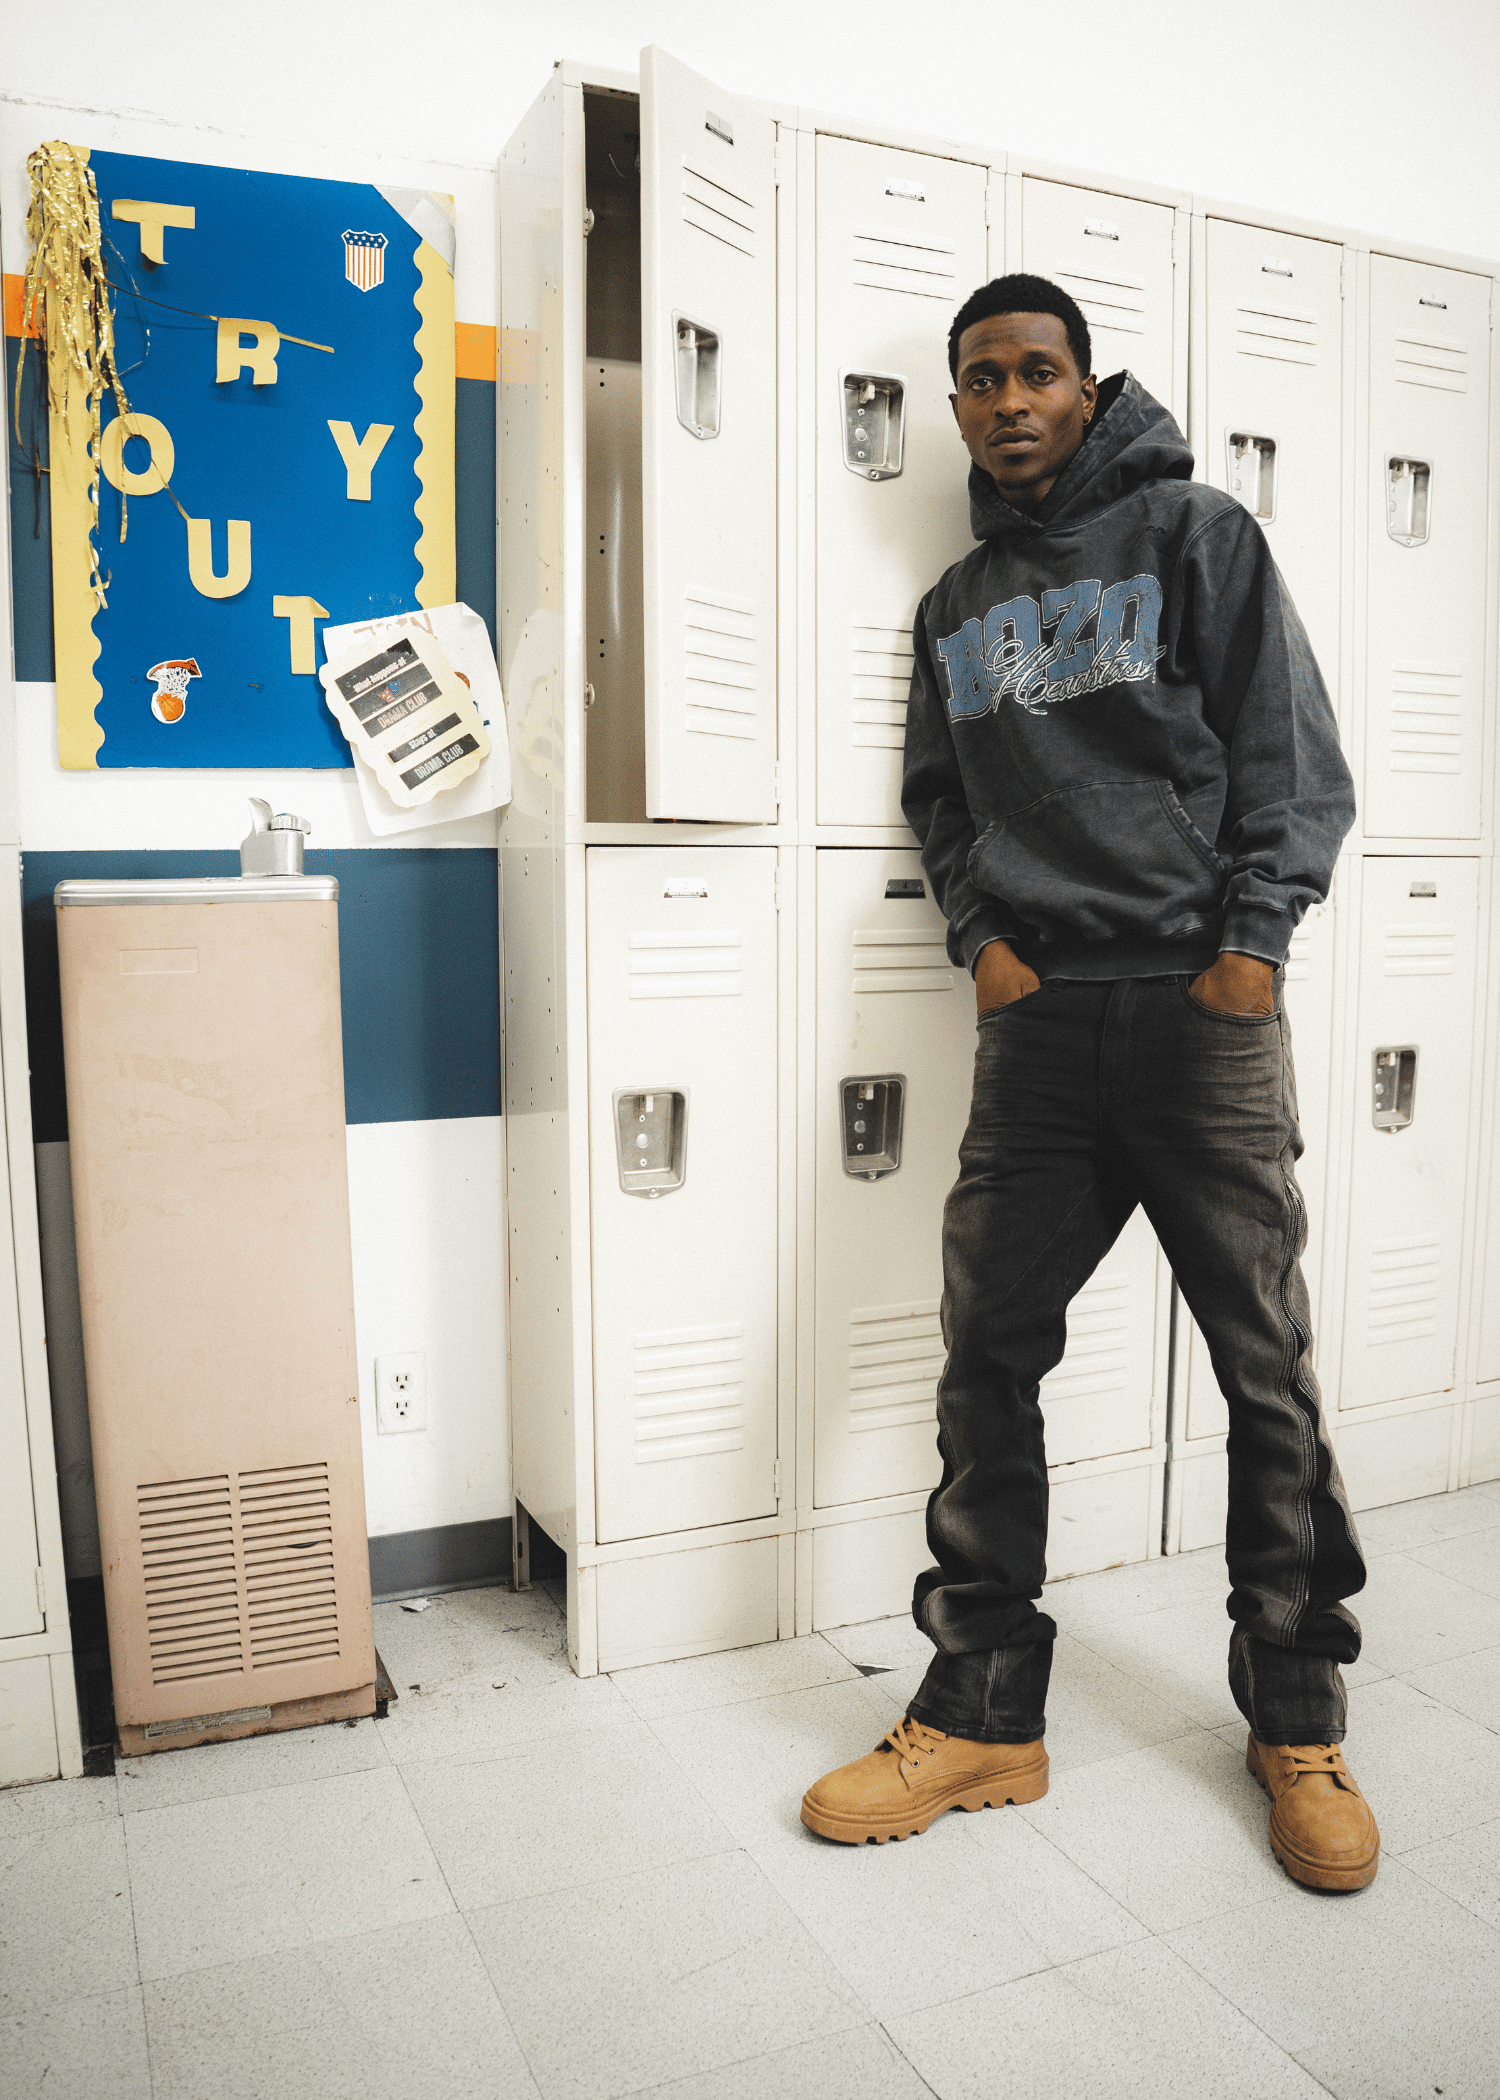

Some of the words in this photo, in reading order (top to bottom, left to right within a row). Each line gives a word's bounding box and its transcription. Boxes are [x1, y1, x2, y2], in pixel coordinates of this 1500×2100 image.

[937, 573, 1163, 723] BOZO
[352, 677, 374, 694] What
[369, 661, 399, 684] happens
[397, 656, 407, 667] at
[377, 704, 408, 729] DRAMA
[405, 691, 428, 712] CLUB
[426, 728, 438, 739] at
[414, 757, 445, 780] DRAMA
[441, 744, 464, 763] CLUB
